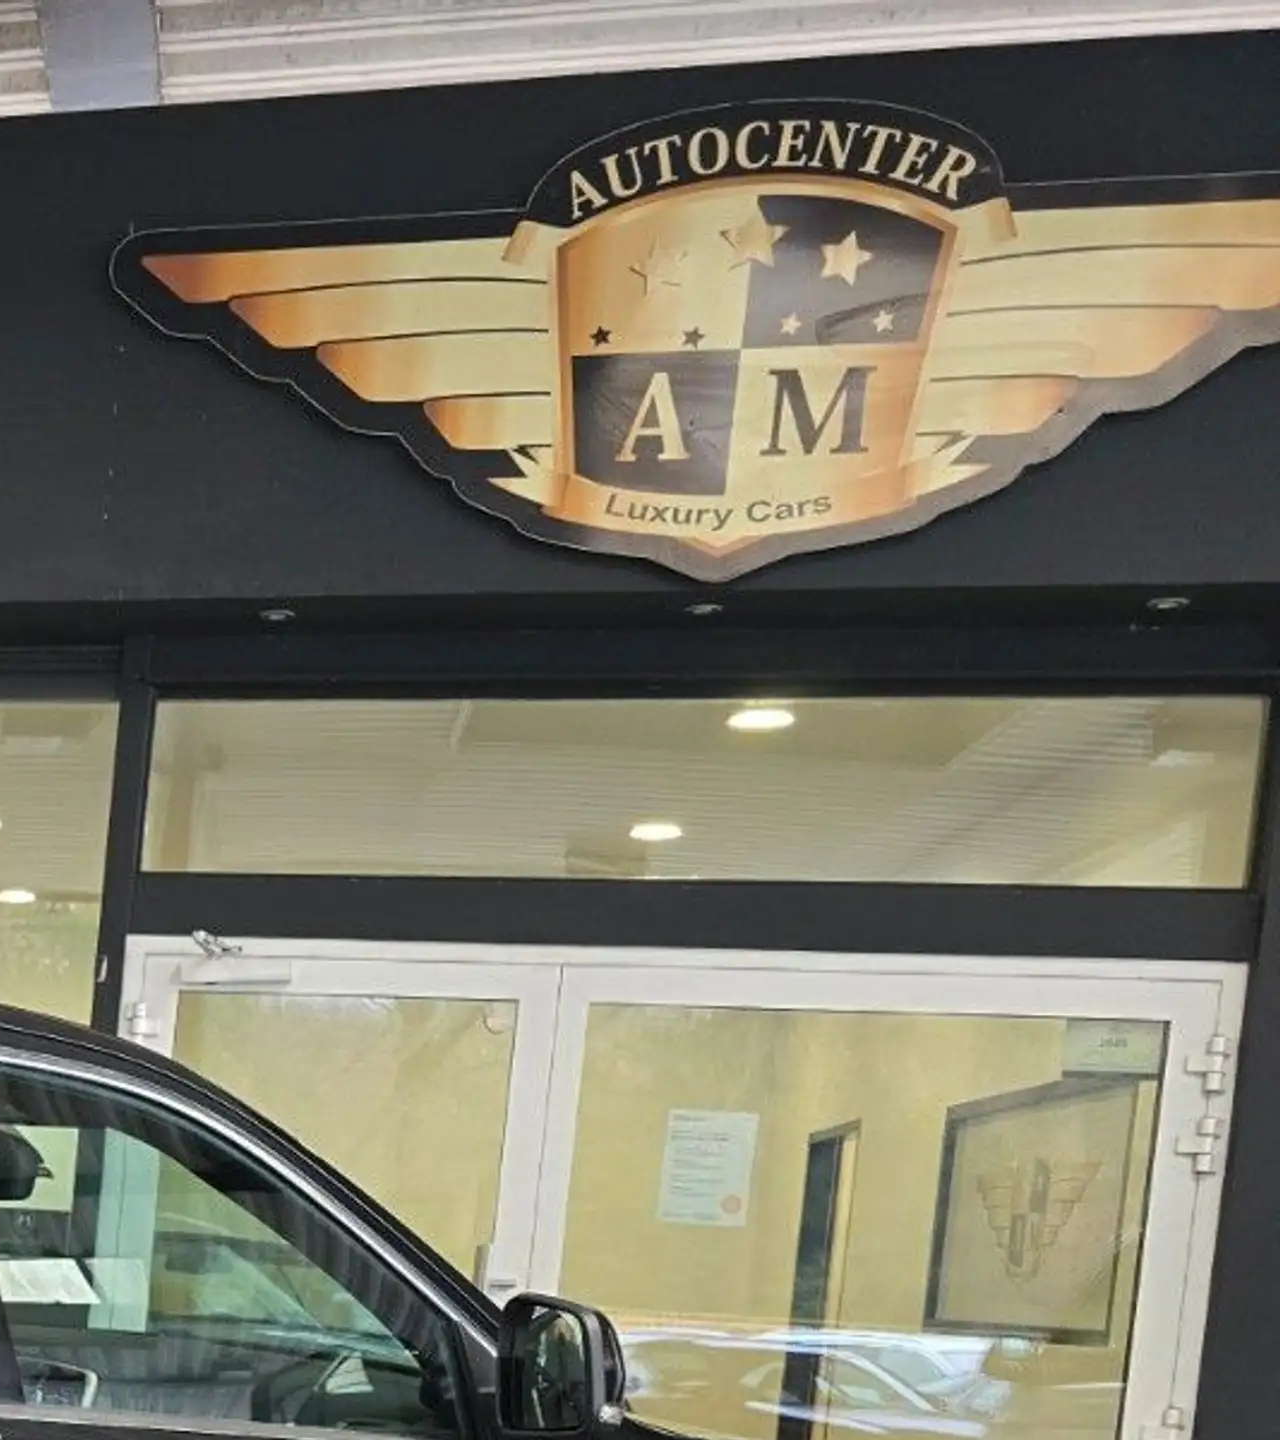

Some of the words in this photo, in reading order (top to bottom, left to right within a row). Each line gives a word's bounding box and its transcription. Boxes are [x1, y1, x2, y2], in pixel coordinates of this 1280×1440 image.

[568, 119, 978, 219] AUTOCENTER
[614, 371, 690, 462] A
[759, 365, 878, 456] M
[603, 493, 734, 532] Luxury
[746, 493, 832, 523] Cars
